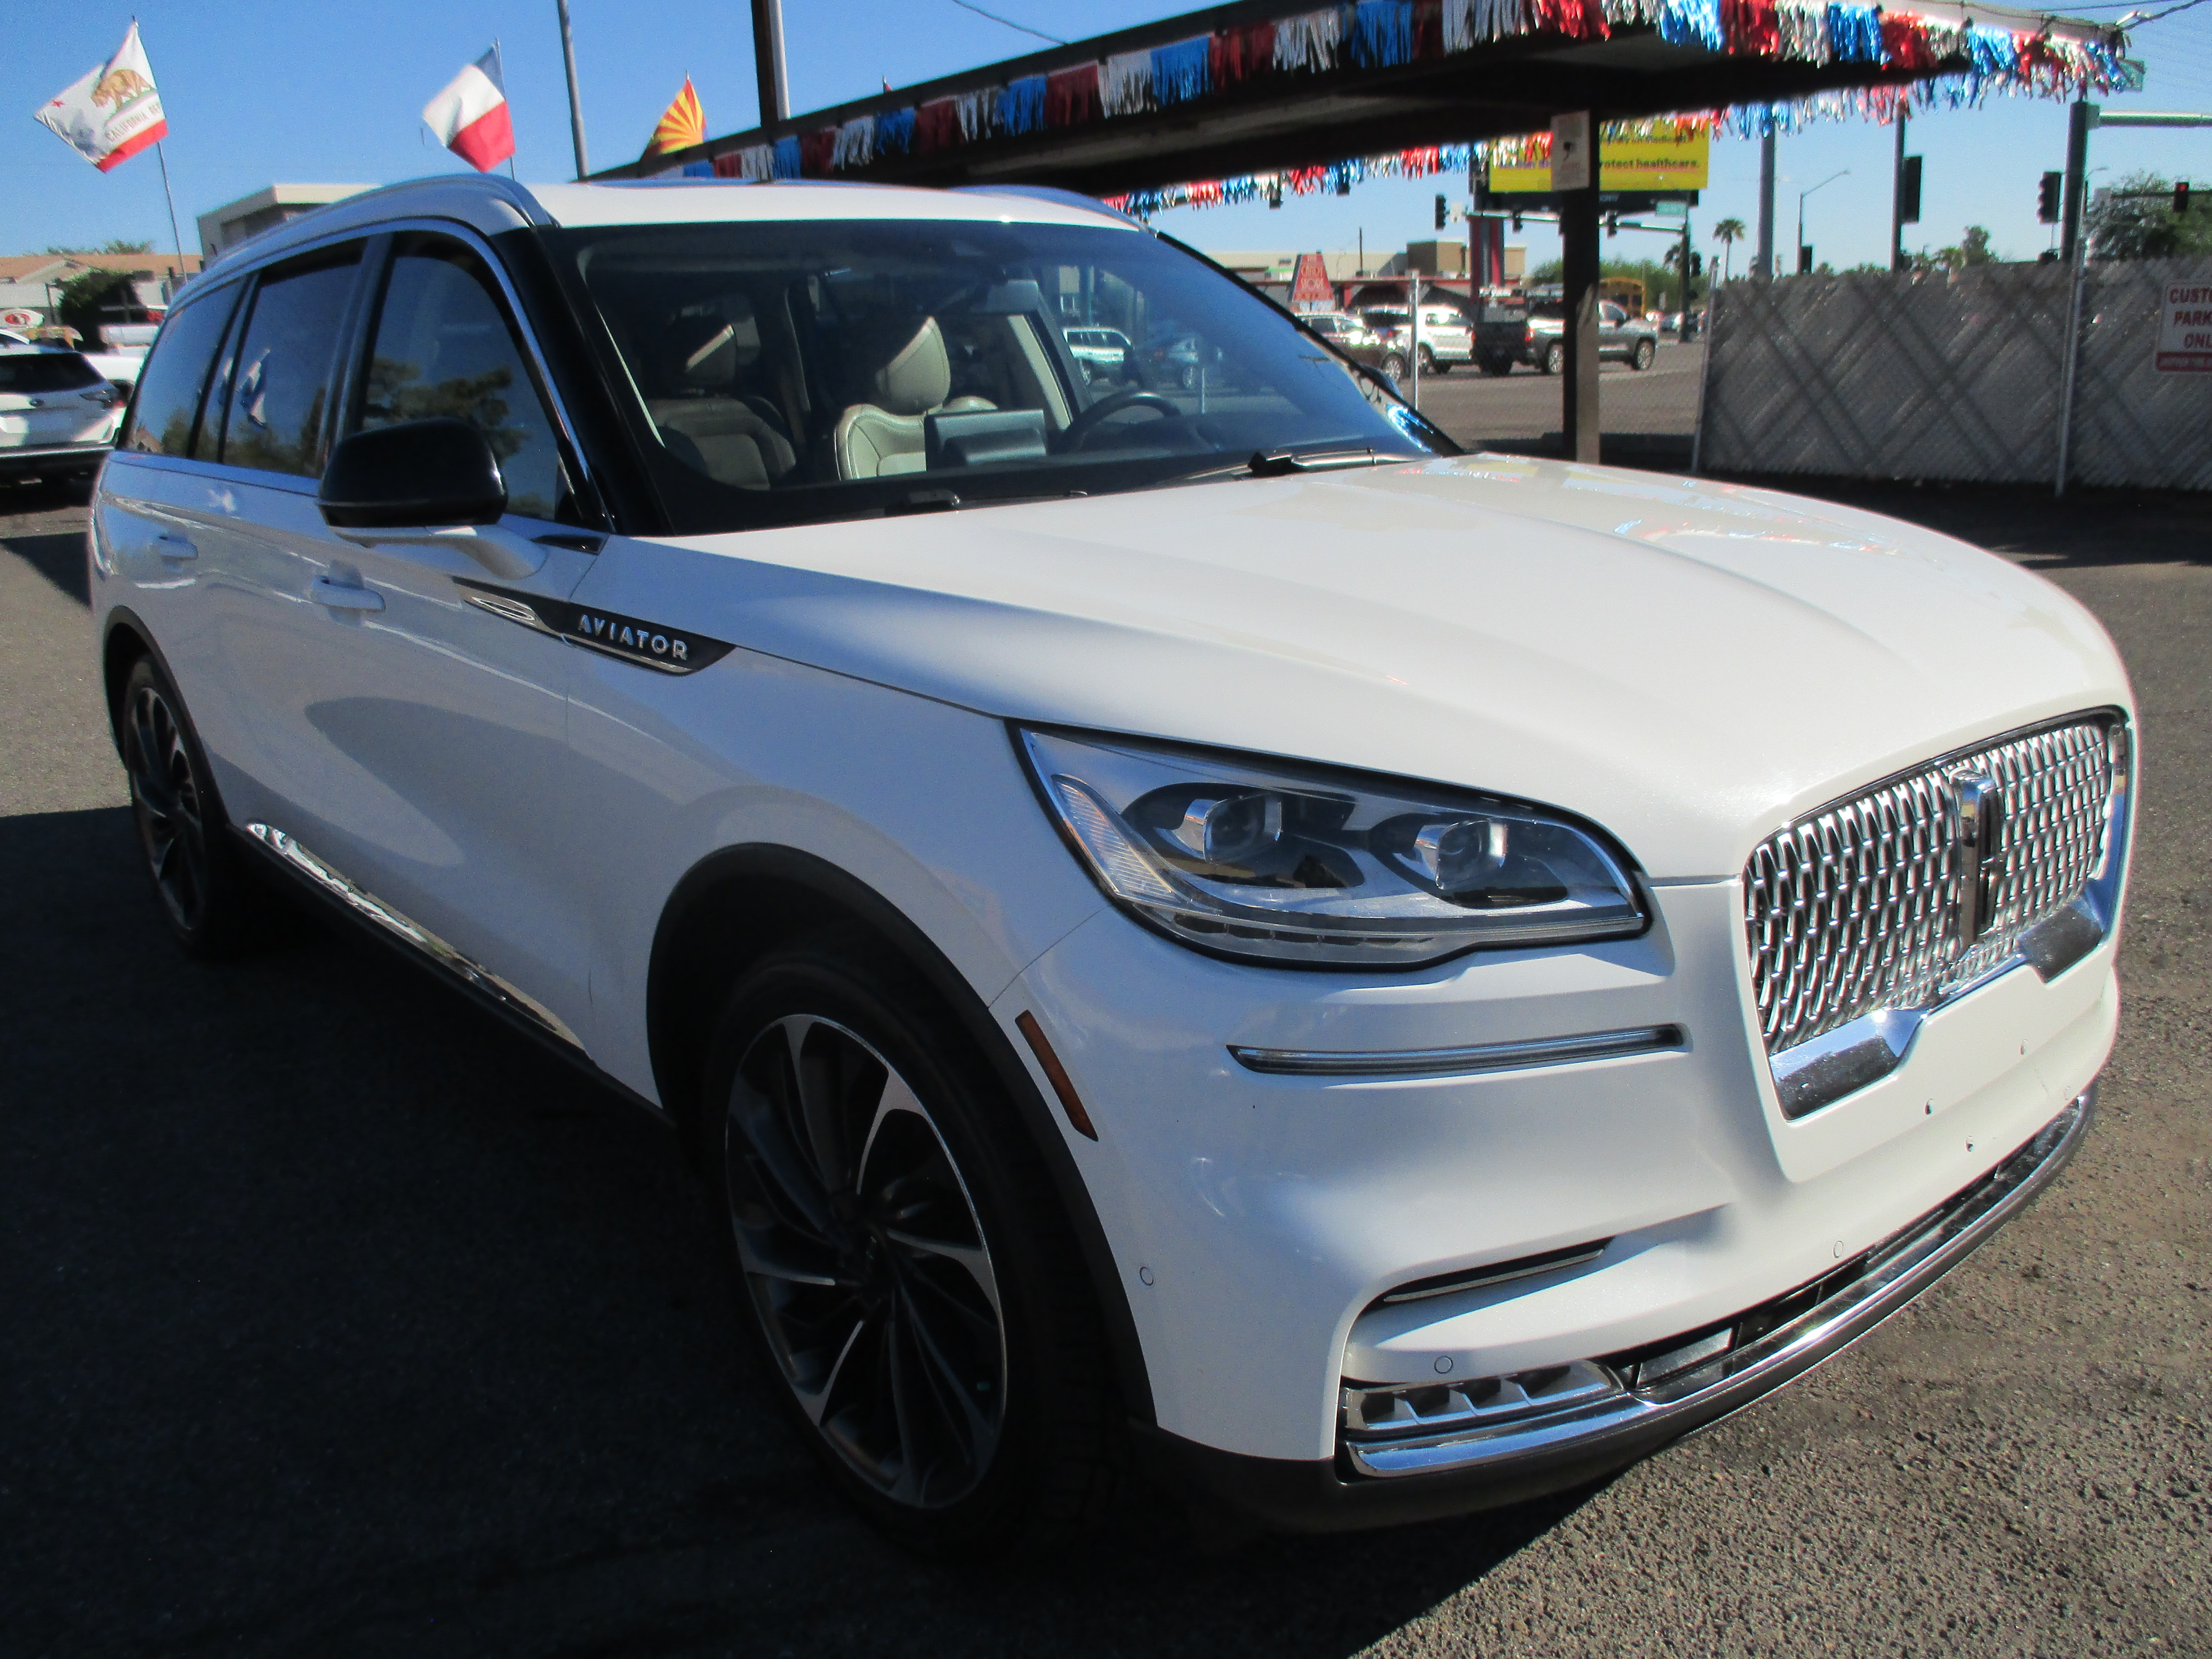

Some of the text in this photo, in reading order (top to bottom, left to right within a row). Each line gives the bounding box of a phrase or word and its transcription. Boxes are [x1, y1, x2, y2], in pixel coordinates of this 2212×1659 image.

[106, 111, 150, 142] CALIFORNIA
[1599, 159, 1634, 169] rotect
[577, 614, 688, 661] AVIATOR
